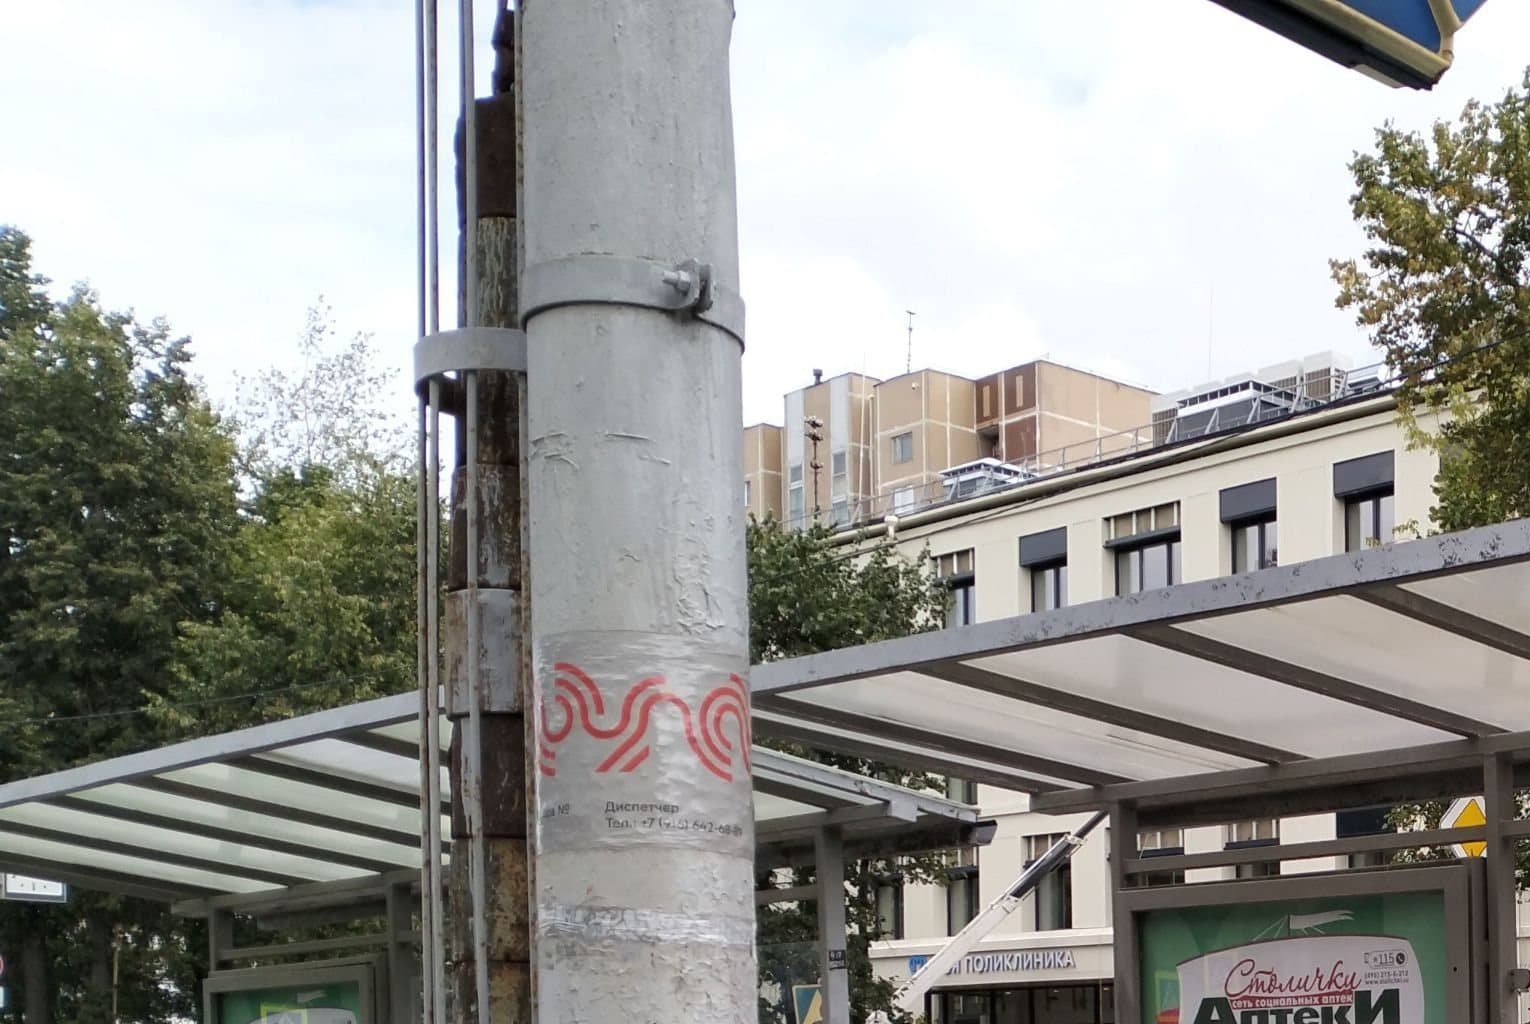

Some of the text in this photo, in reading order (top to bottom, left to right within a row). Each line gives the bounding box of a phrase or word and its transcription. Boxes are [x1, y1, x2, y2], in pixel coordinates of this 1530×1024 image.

[604, 801, 680, 814] Диспетчер
[966, 951, 1076, 974] ПОЛИКЛИНИКА
[1224, 959, 1362, 998] Столички
[1232, 994, 1353, 1009] сеть социальных аптек
